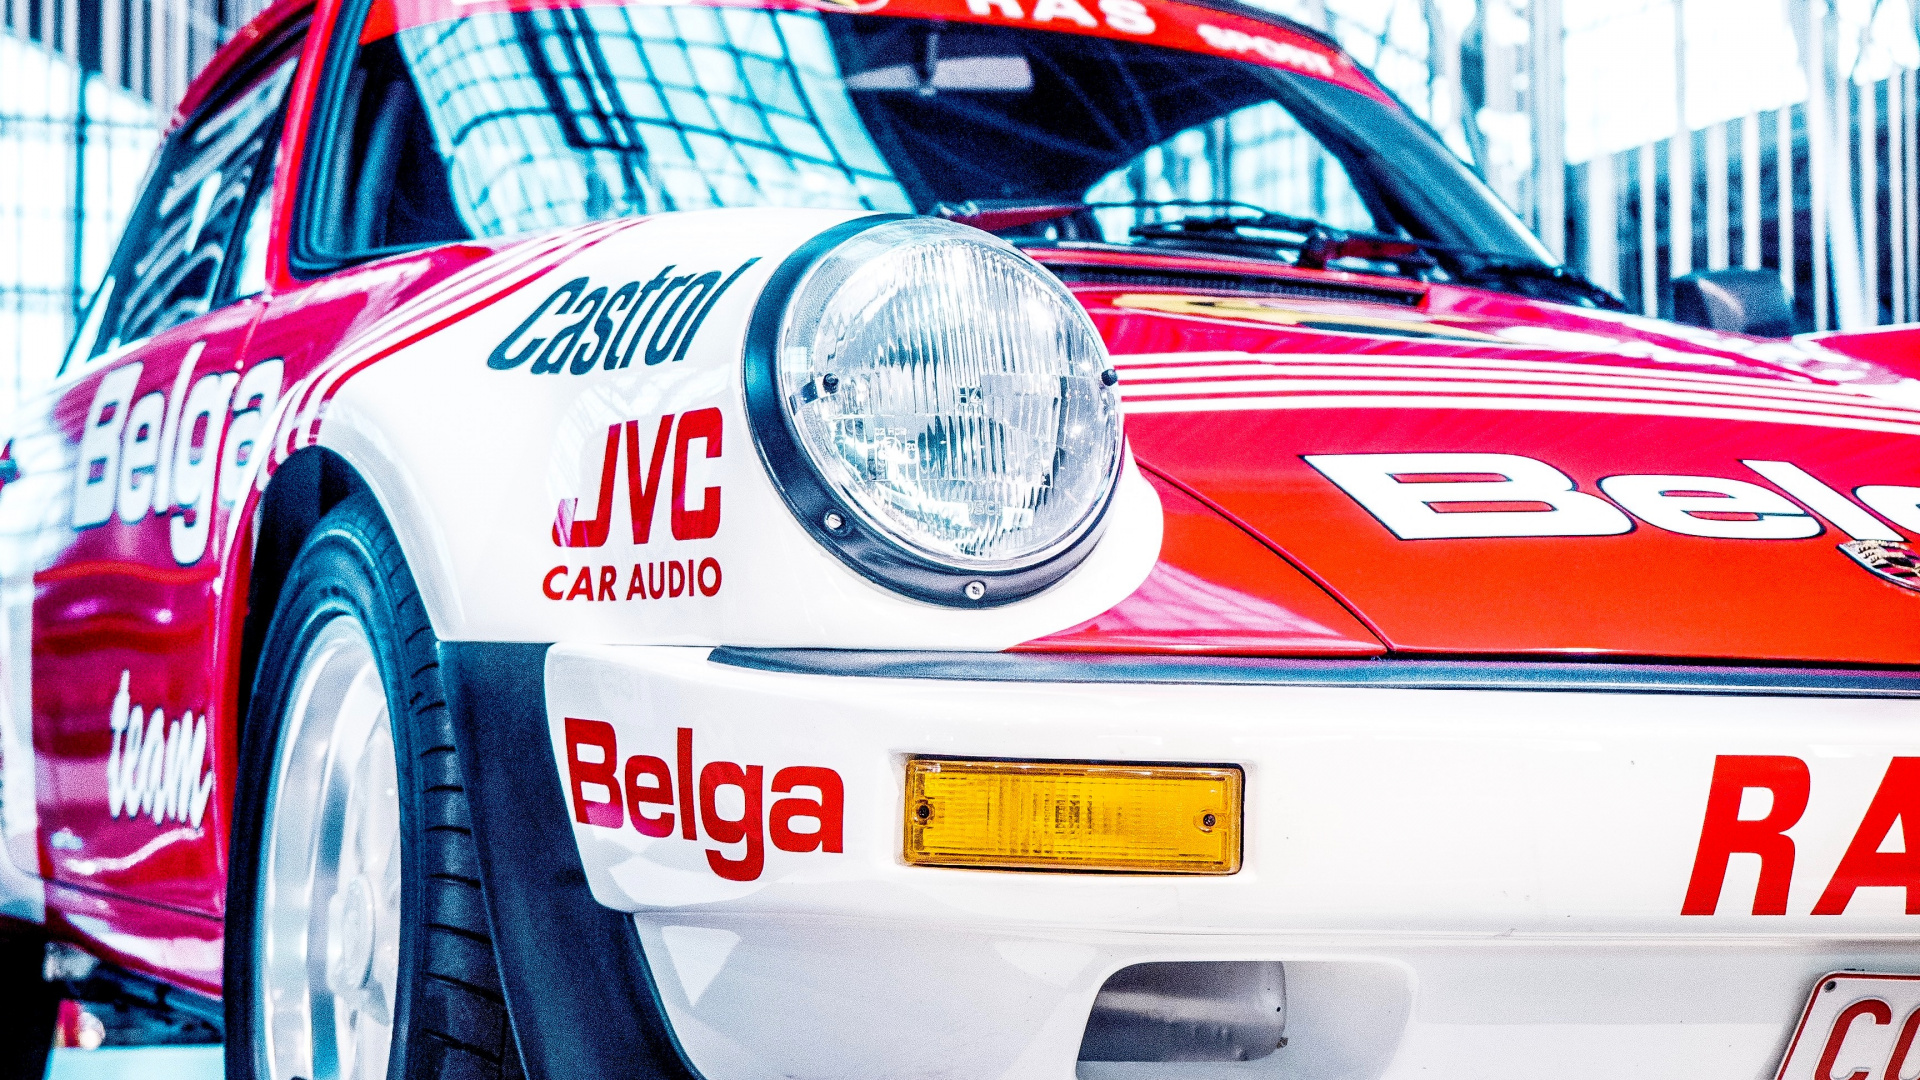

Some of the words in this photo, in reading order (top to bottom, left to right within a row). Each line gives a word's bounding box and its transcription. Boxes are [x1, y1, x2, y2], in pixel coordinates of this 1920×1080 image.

[487, 257, 760, 375] Castrol
[73, 339, 285, 566] Belga
[552, 407, 723, 548] JVC
[542, 565, 617, 601] CAR
[626, 557, 722, 601] AUDIO
[107, 669, 213, 829] team
[564, 717, 844, 882] Belga
[1680, 754, 1920, 915] RA
